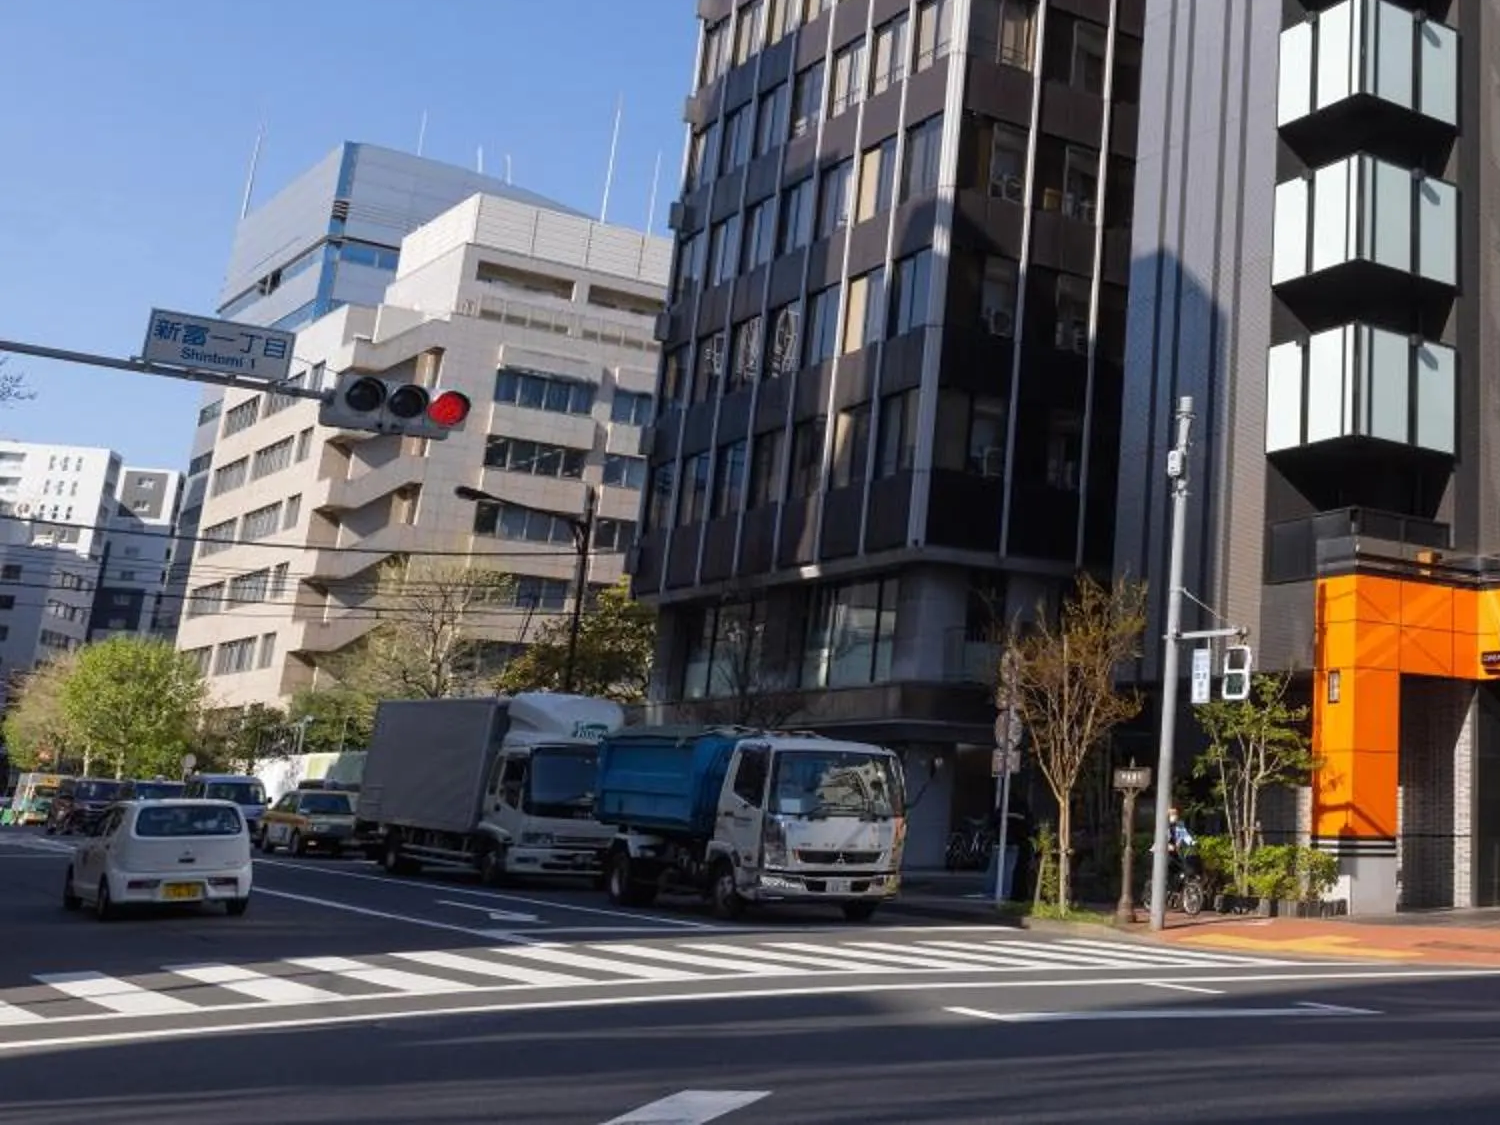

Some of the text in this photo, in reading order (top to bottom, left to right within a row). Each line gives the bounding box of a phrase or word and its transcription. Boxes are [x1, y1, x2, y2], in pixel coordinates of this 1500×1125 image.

[154, 319, 287, 360] 新富一丁目
